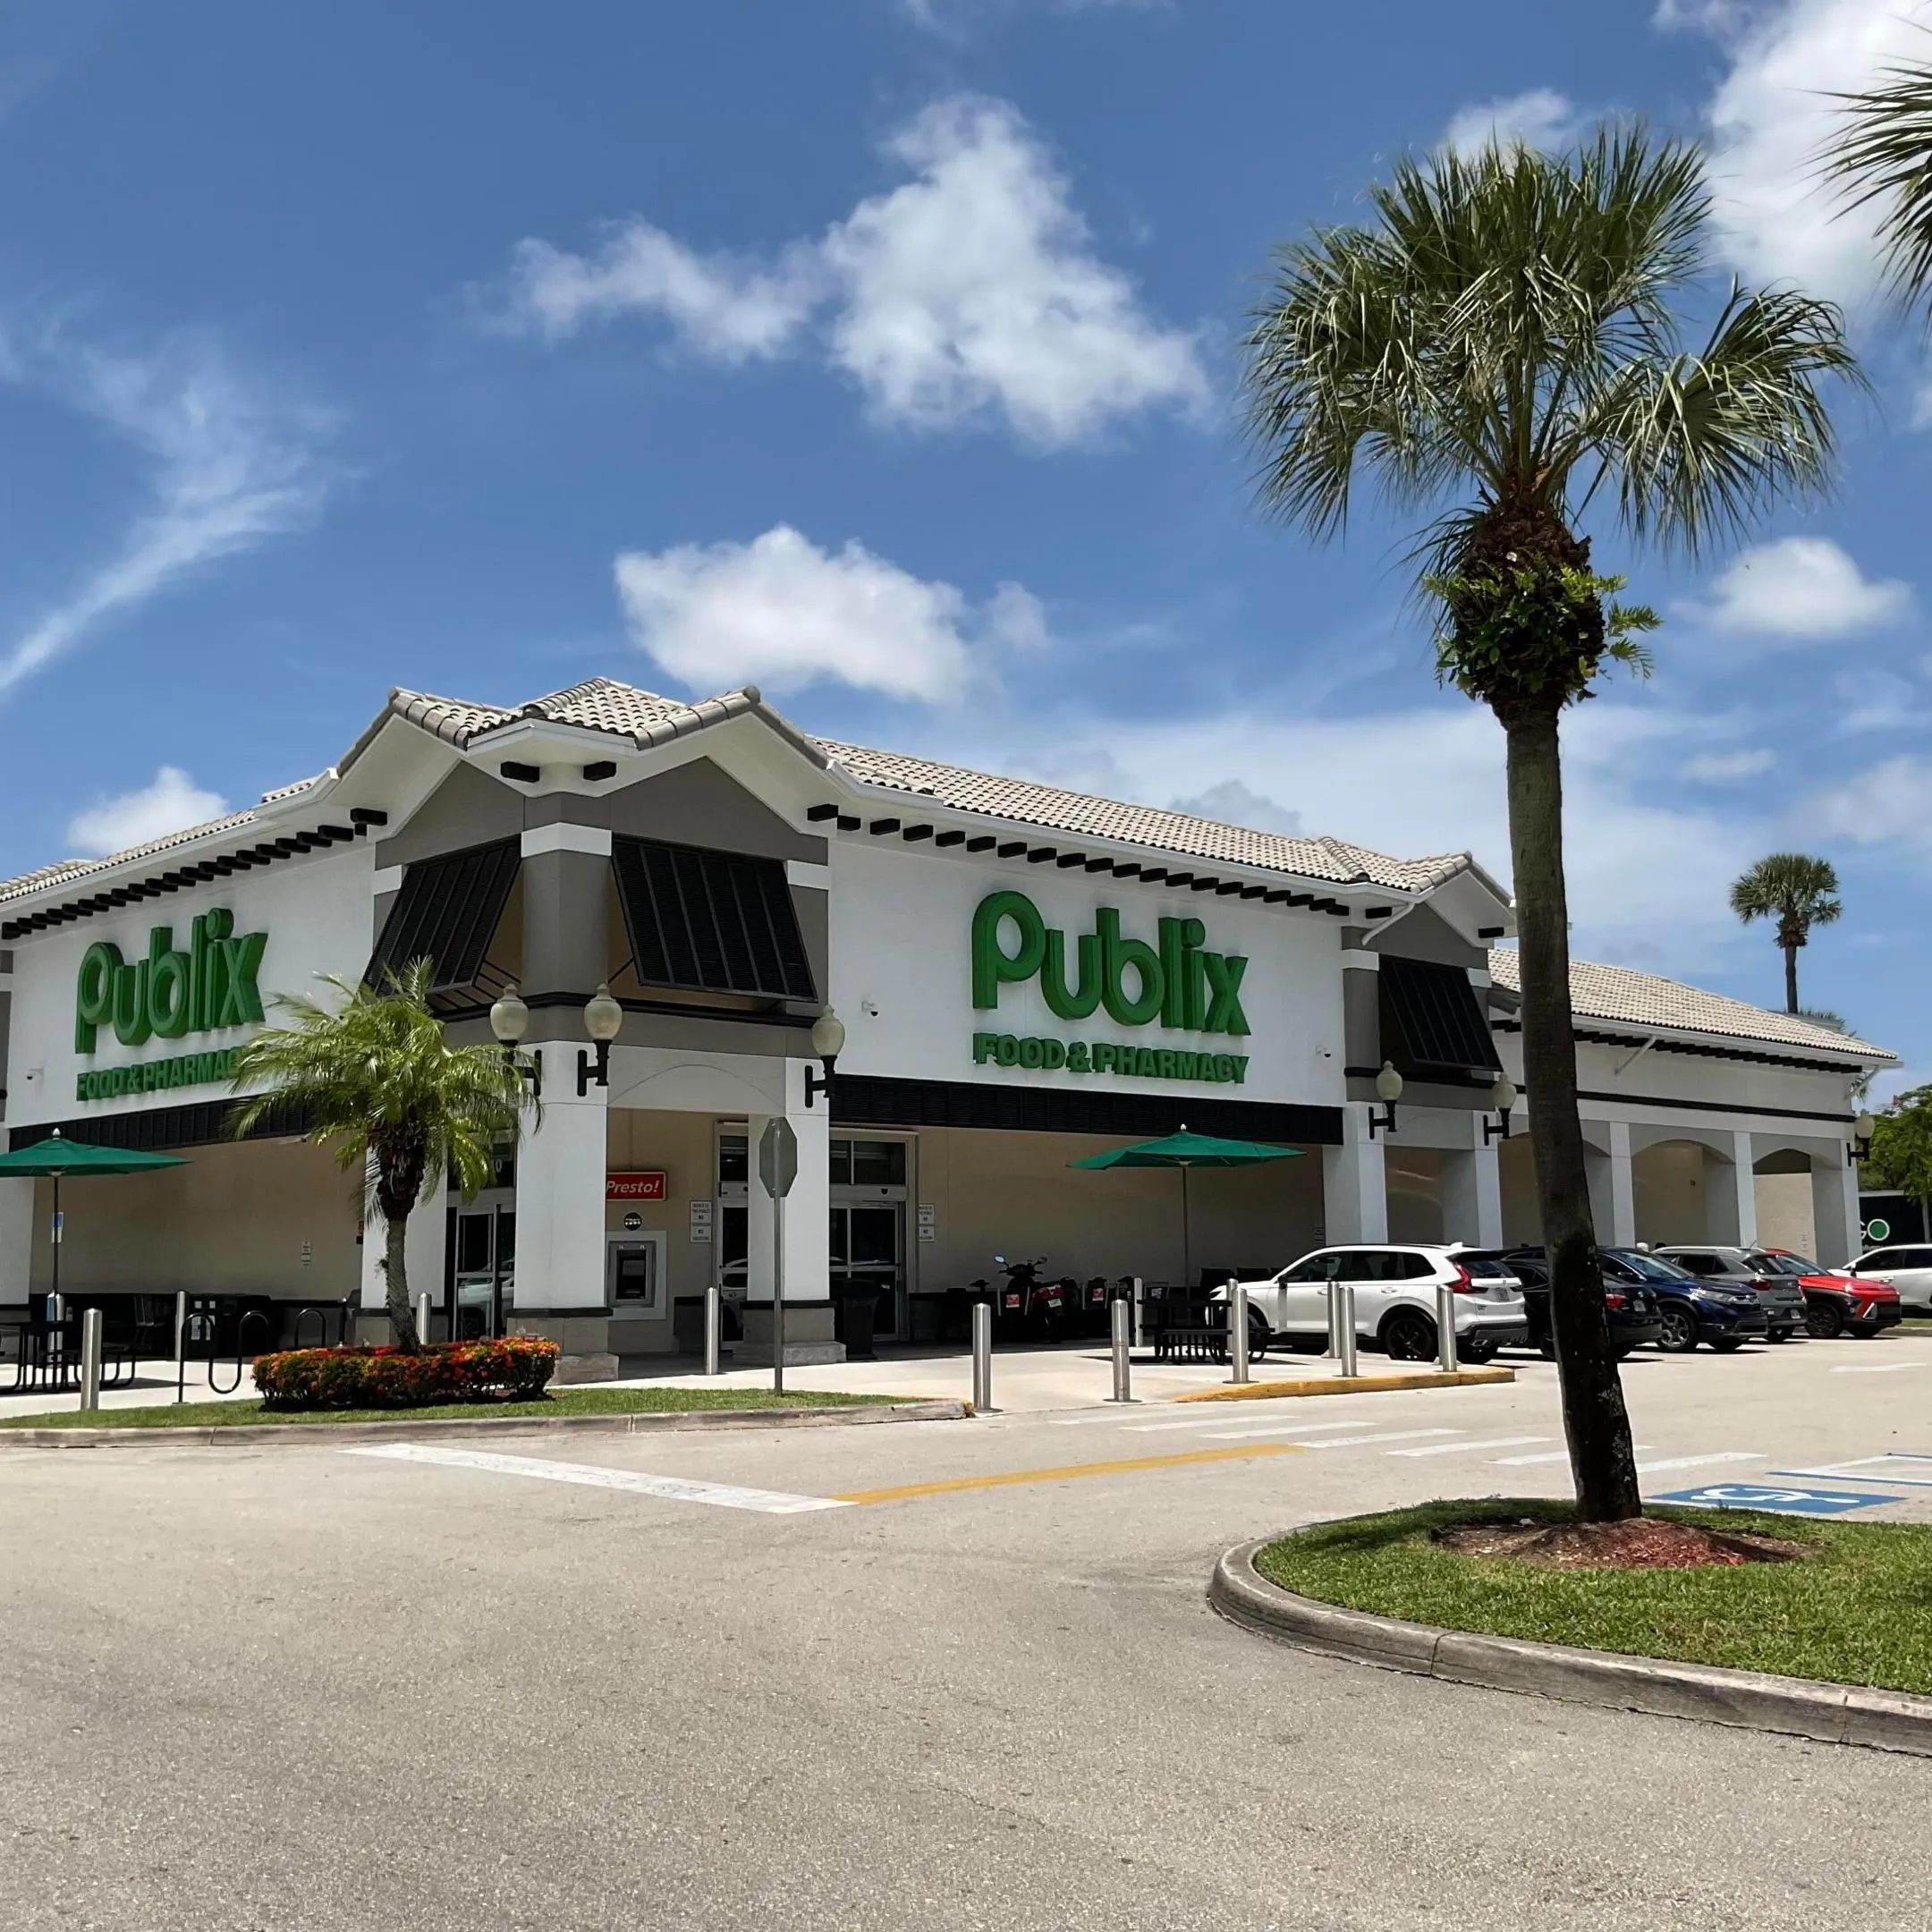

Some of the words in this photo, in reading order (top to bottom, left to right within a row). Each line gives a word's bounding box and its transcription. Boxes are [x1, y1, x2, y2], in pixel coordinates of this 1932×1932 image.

[75, 908, 268, 1054] Publix
[972, 890, 1251, 1036] Publix
[606, 1180, 660, 1193] Presto!
